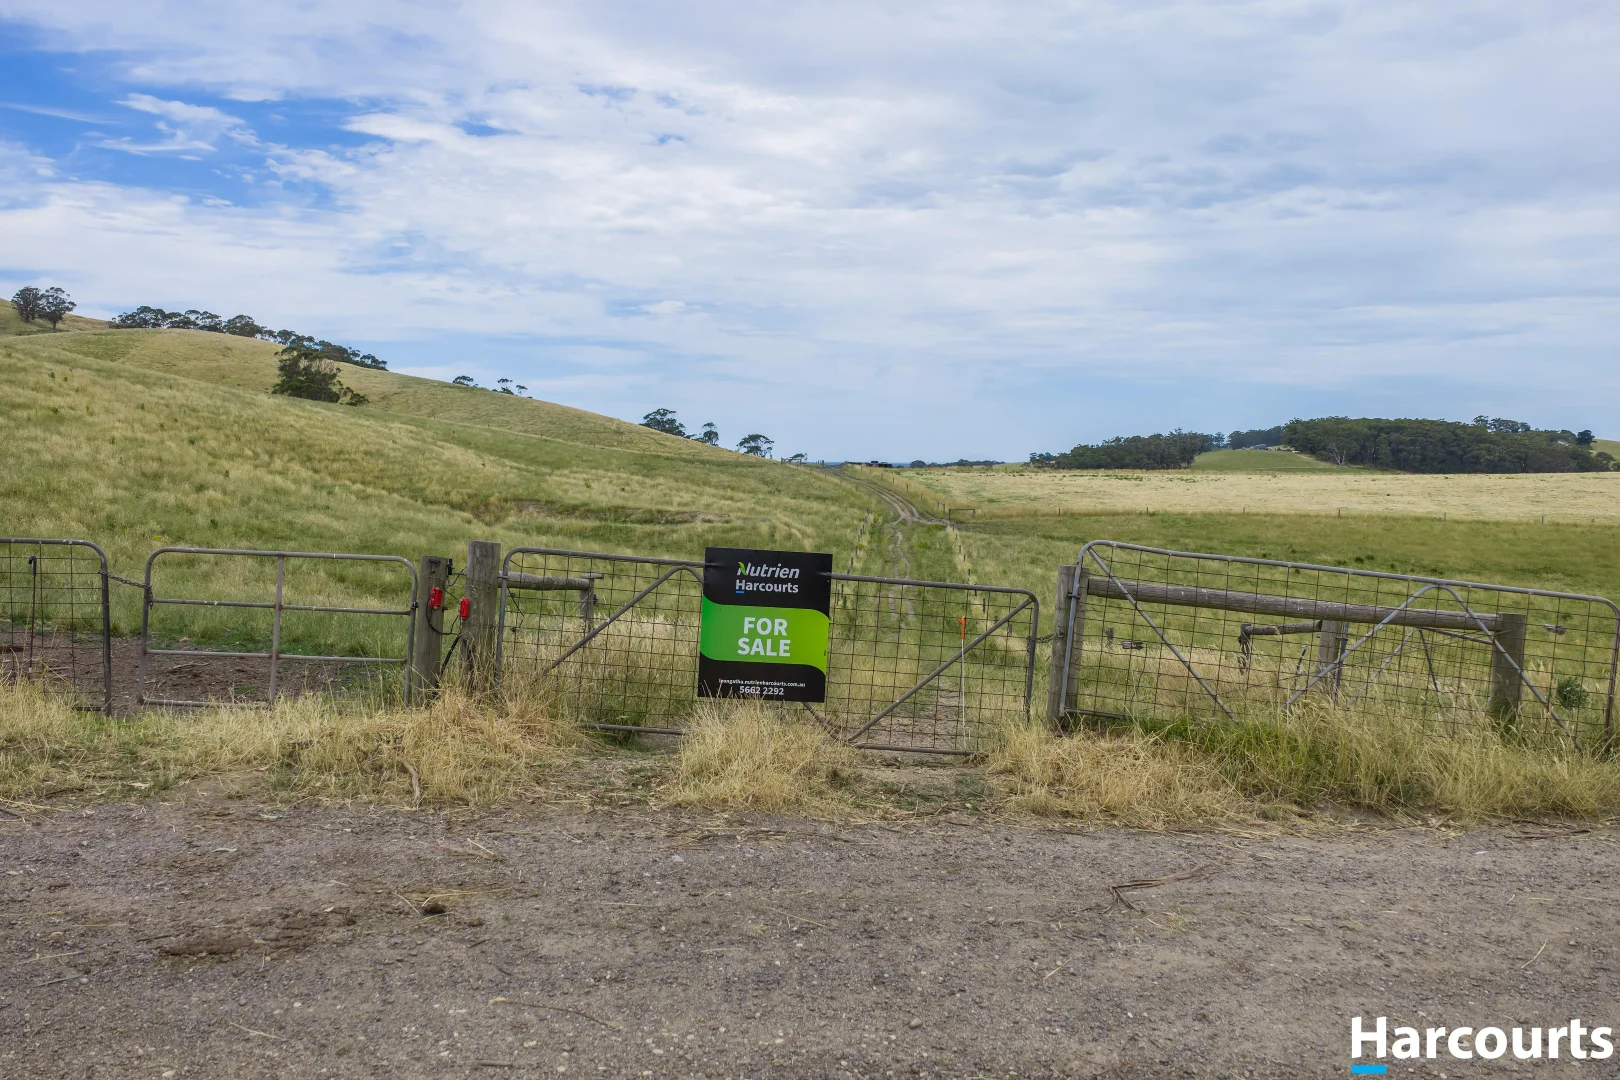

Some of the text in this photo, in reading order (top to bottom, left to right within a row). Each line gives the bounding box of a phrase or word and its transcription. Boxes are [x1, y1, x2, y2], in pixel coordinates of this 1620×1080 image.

[737, 562, 800, 579] Nutrien
[735, 579, 799, 593] Harcourts
[743, 617, 788, 636] FOR
[737, 637, 791, 657] SALE
[763, 687, 785, 696] 2292
